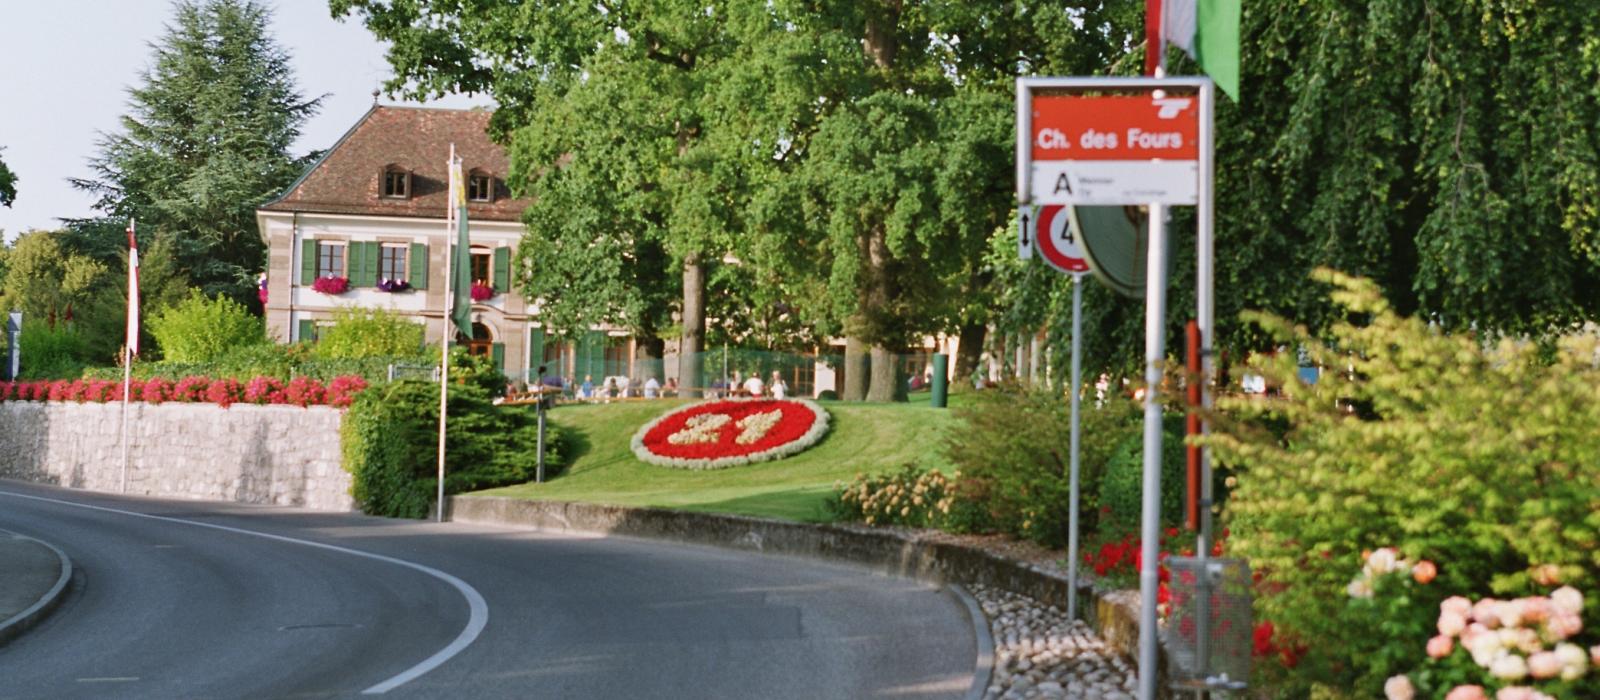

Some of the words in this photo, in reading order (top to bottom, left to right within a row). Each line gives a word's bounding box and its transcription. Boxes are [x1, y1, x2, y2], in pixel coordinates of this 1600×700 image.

[1037, 128, 1070, 148] Ch.
[1080, 129, 1118, 149] des
[1127, 128, 1183, 149] Fours
[1053, 172, 1072, 195] A
[1061, 218, 1074, 245] 4
[667, 408, 783, 445] 21
